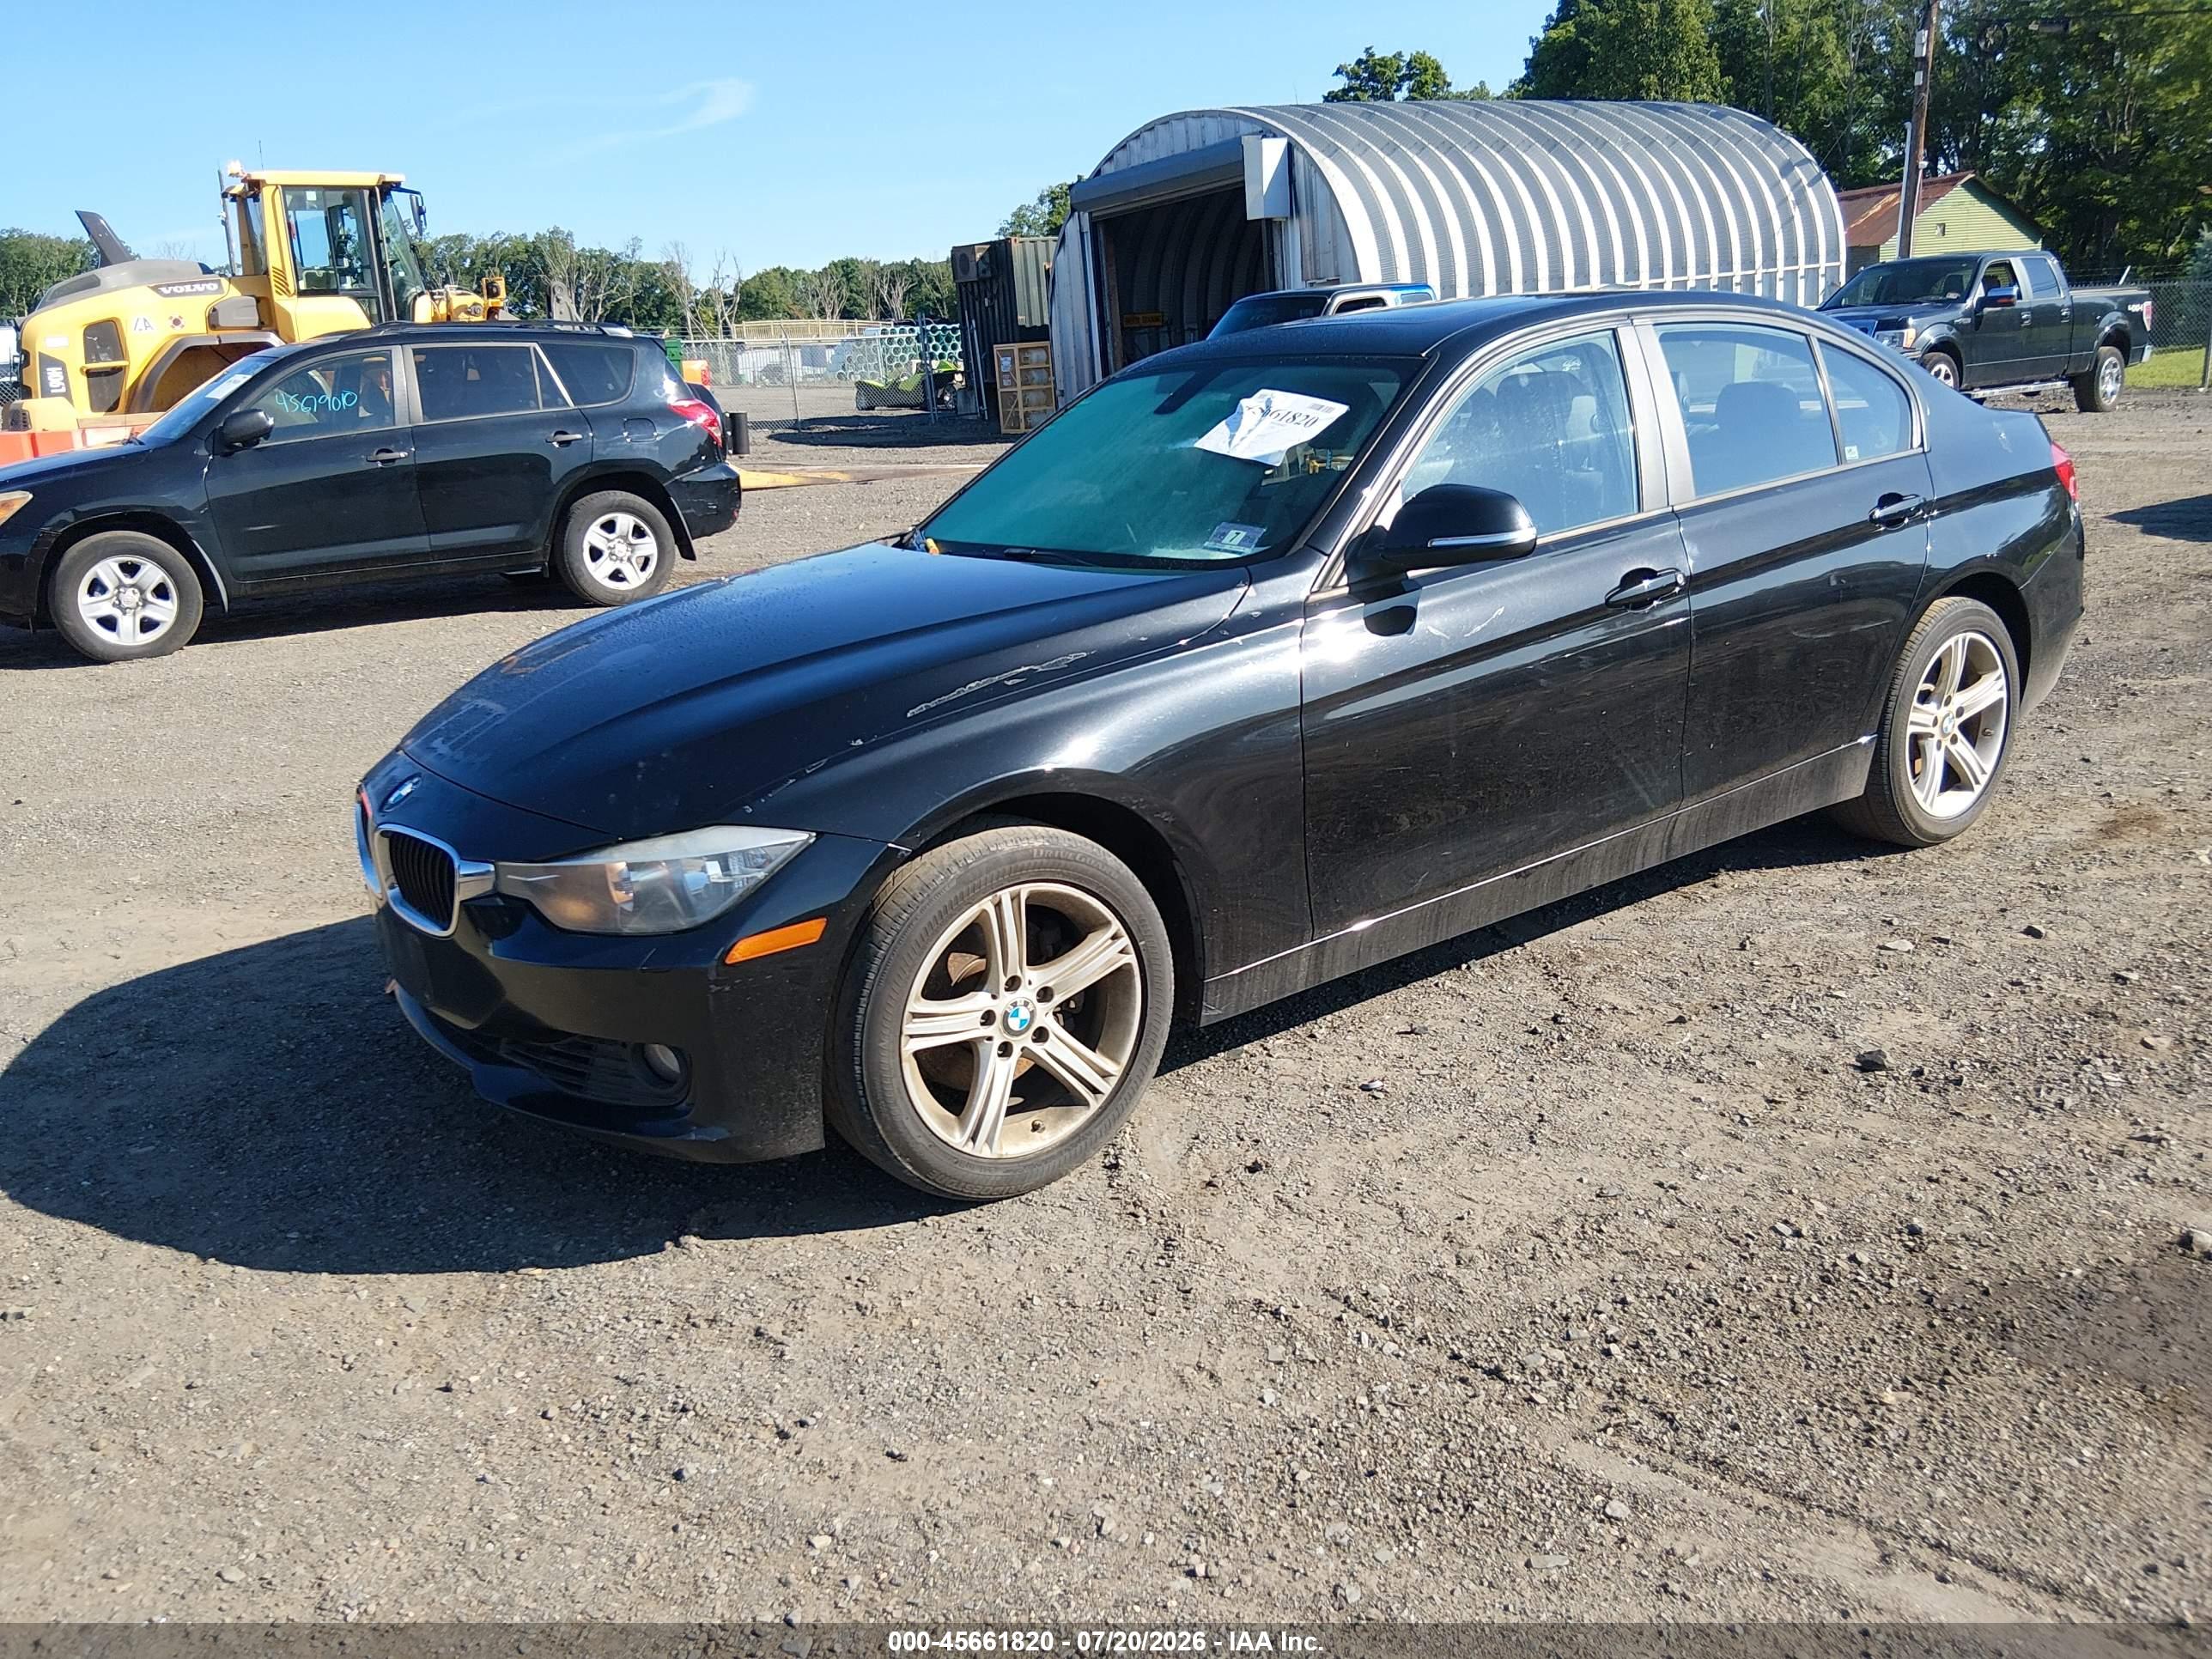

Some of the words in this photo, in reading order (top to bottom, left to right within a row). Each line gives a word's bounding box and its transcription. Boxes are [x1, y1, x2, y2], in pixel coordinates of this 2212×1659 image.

[158, 282, 219, 295] VOLVO
[46, 367, 67, 394] L90H
[1246, 405, 1320, 428] 61820
